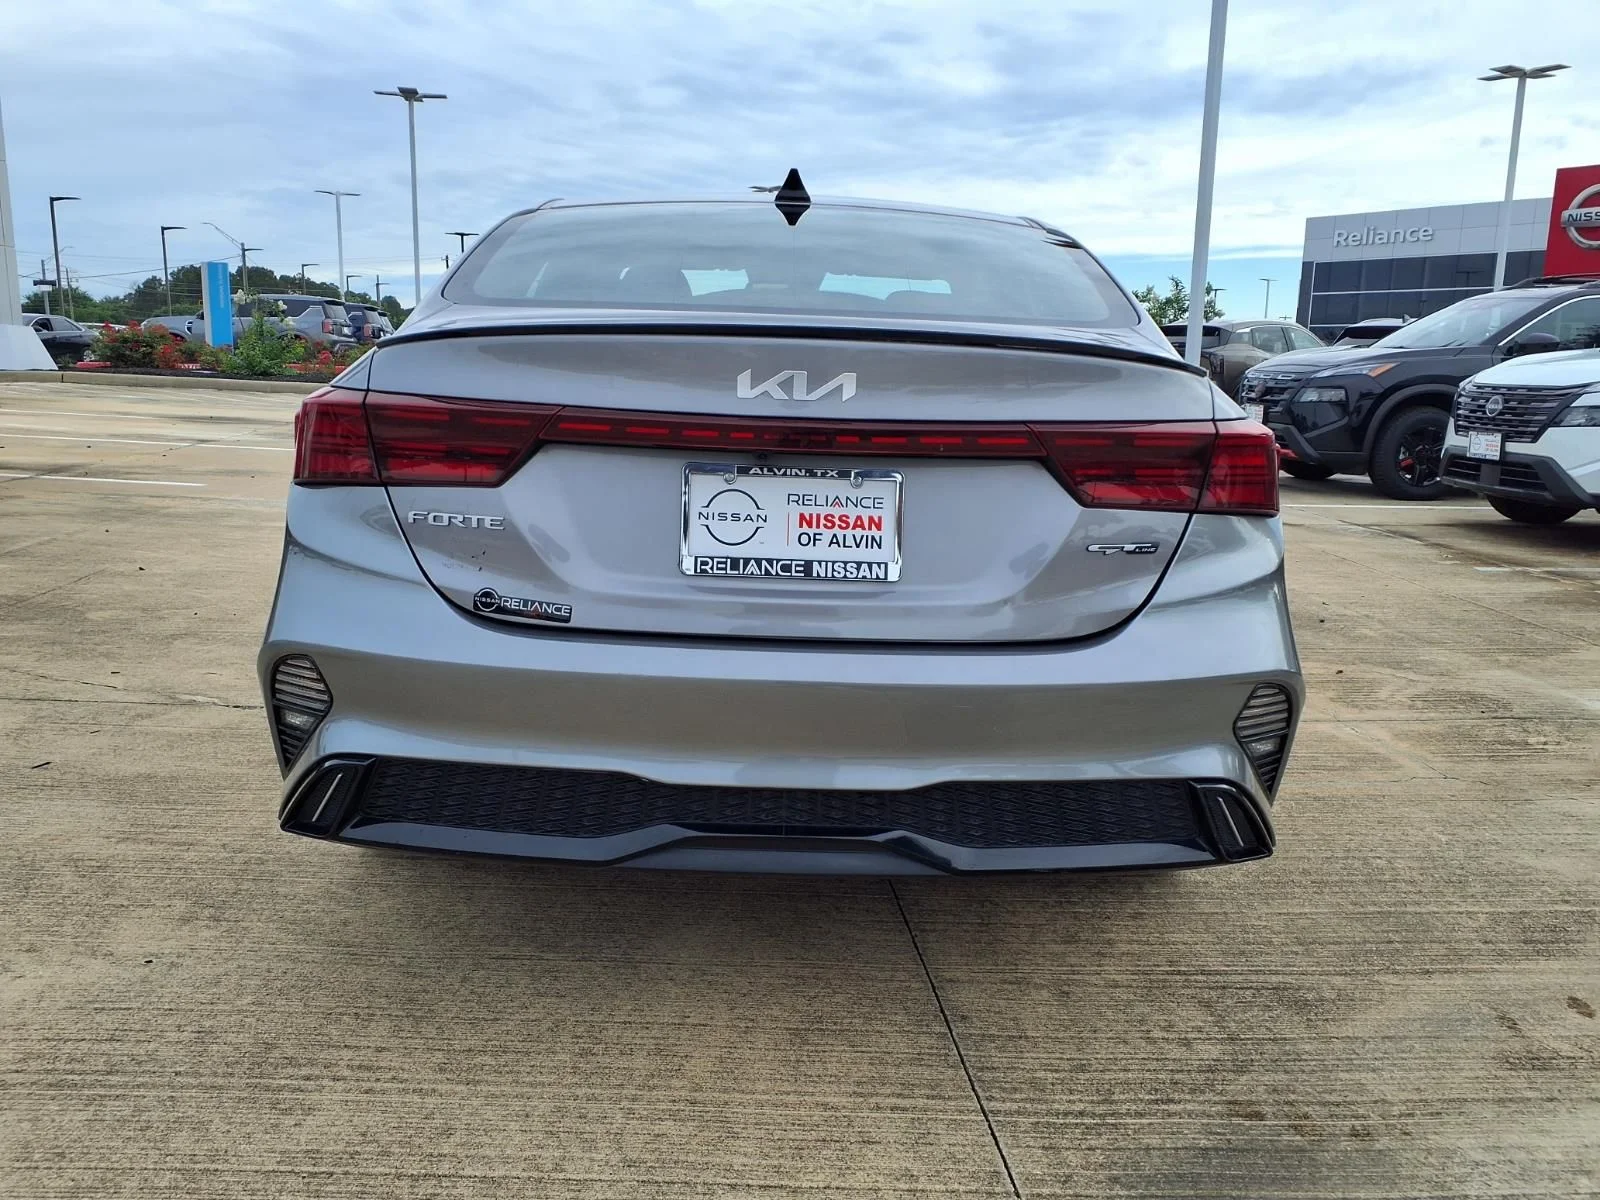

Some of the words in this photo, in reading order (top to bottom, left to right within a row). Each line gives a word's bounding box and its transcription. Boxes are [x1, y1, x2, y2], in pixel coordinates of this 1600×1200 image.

[1333, 225, 1434, 248] Reliance
[737, 368, 857, 402] KIA
[813, 469, 839, 478] TX
[787, 493, 884, 509] RELIANCE
[408, 510, 505, 530] FORTE
[698, 511, 768, 523] NISSAN
[798, 512, 883, 532] NISSAN
[797, 532, 823, 548] OF
[827, 532, 882, 550] ALVIN
[696, 558, 805, 577] RELIANCE
[812, 563, 886, 579] NISSAN
[501, 597, 571, 616] RELIANCE
